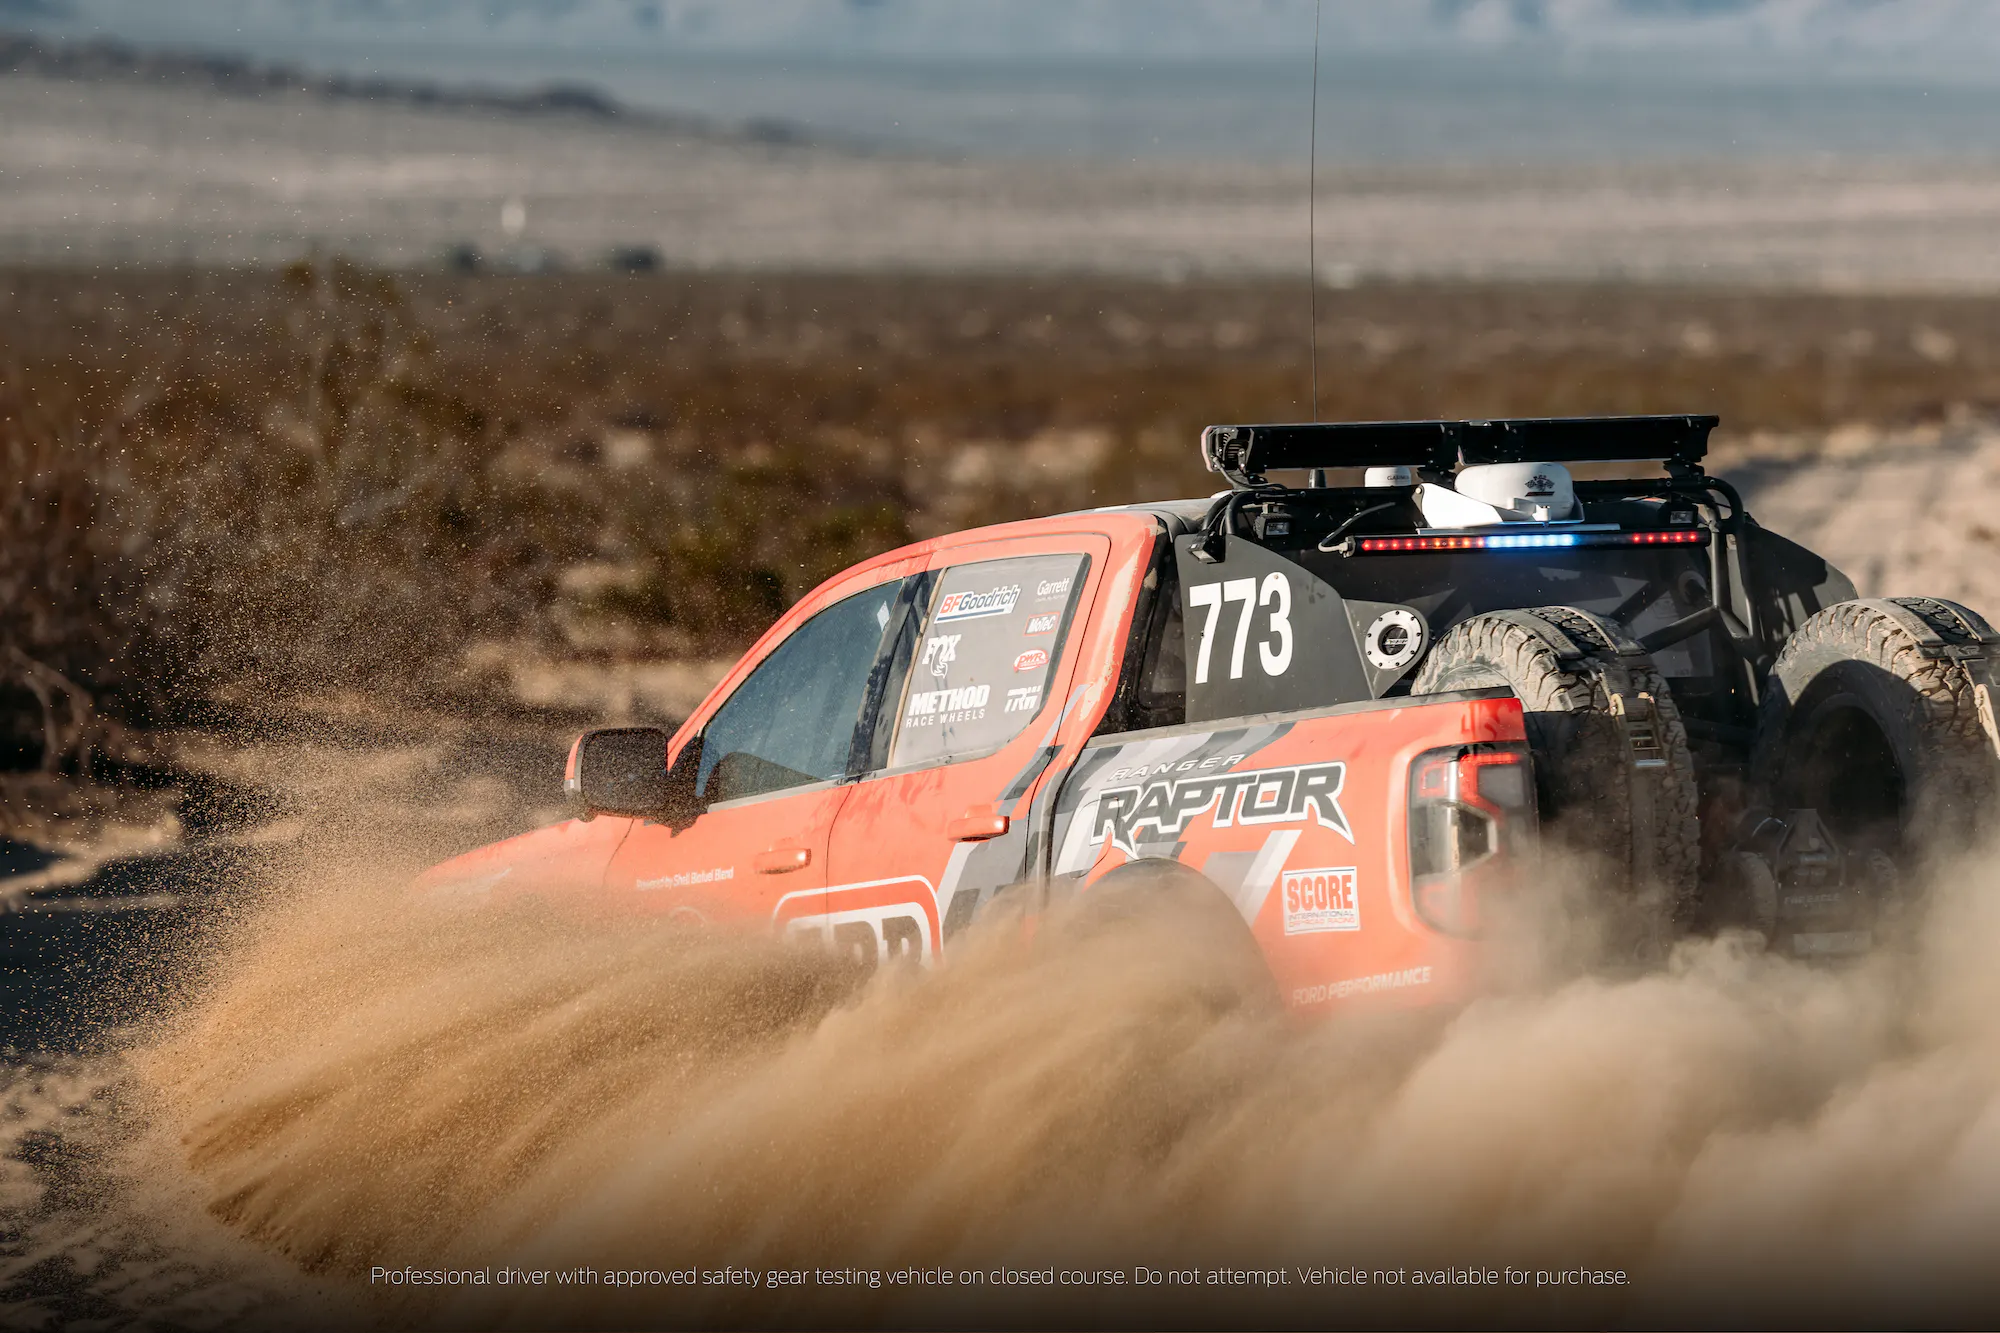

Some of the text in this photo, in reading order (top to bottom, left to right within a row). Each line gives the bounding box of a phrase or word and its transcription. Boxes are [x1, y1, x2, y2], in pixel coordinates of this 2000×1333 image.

[940, 586, 1018, 614] BFGoodrich
[1037, 577, 1070, 596] Garrett
[1189, 571, 1293, 684] 773
[922, 634, 962, 678] FOX
[908, 684, 991, 717] METHOD
[905, 708, 986, 728] RACE WHEELS
[1106, 753, 1246, 782] RANGER
[1089, 760, 1356, 860] RAPTOR
[673, 872, 691, 887] Shell
[714, 866, 734, 881] Blend
[1287, 875, 1353, 913] SCORE
[1292, 966, 1433, 1008] FORD PERFORMANCE
